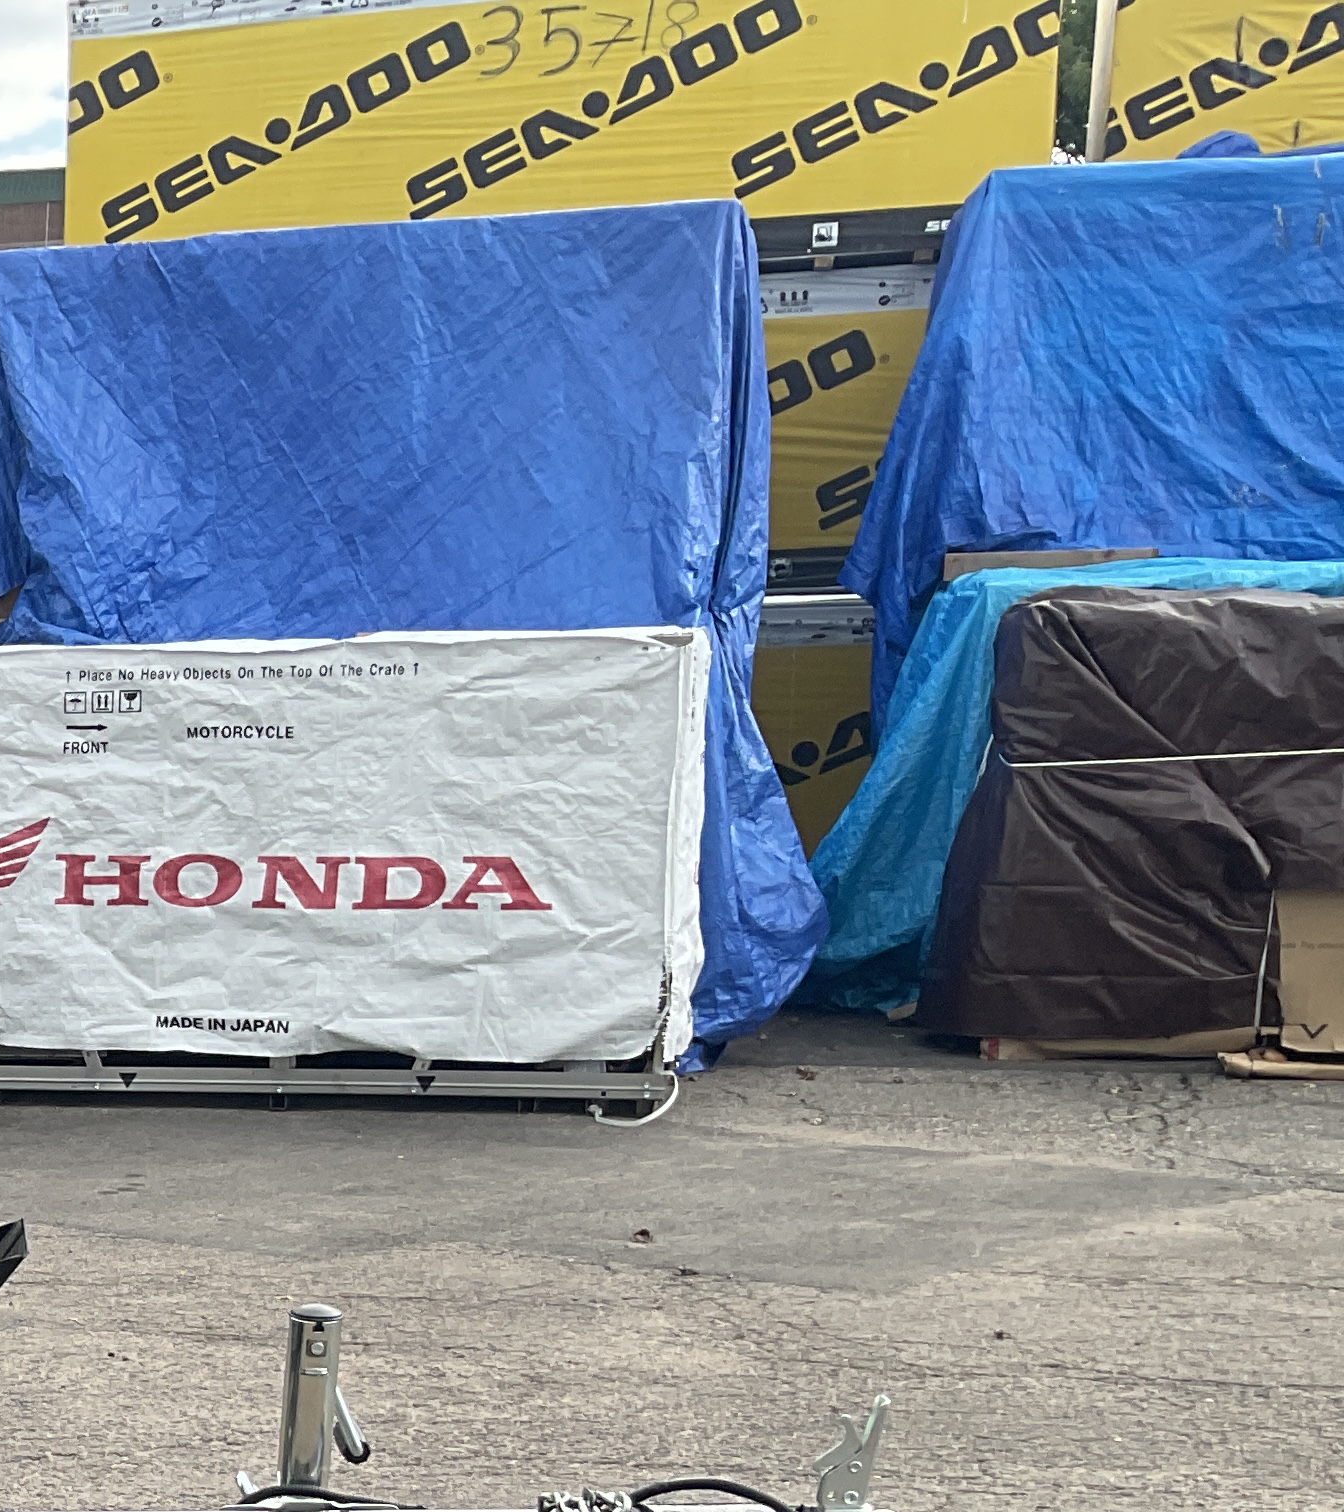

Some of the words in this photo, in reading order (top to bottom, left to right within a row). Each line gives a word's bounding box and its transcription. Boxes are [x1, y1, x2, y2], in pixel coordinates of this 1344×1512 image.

[79, 670, 112, 682] Place
[118, 669, 135, 681] No
[140, 668, 180, 681] Heavy
[183, 667, 232, 681] Objects
[237, 666, 254, 679] On
[261, 666, 284, 679] The
[290, 665, 313, 679] Top
[319, 664, 333, 677] Of
[340, 664, 363, 677] The
[370, 663, 405, 677] Crate
[187, 725, 294, 739] MOTORCYCLE
[63, 741, 109, 755] FRONT
[54, 853, 553, 911] HONDA
[155, 1015, 203, 1029] MADE
[208, 1018, 226, 1031] IN
[230, 1019, 290, 1034] JAPAN
